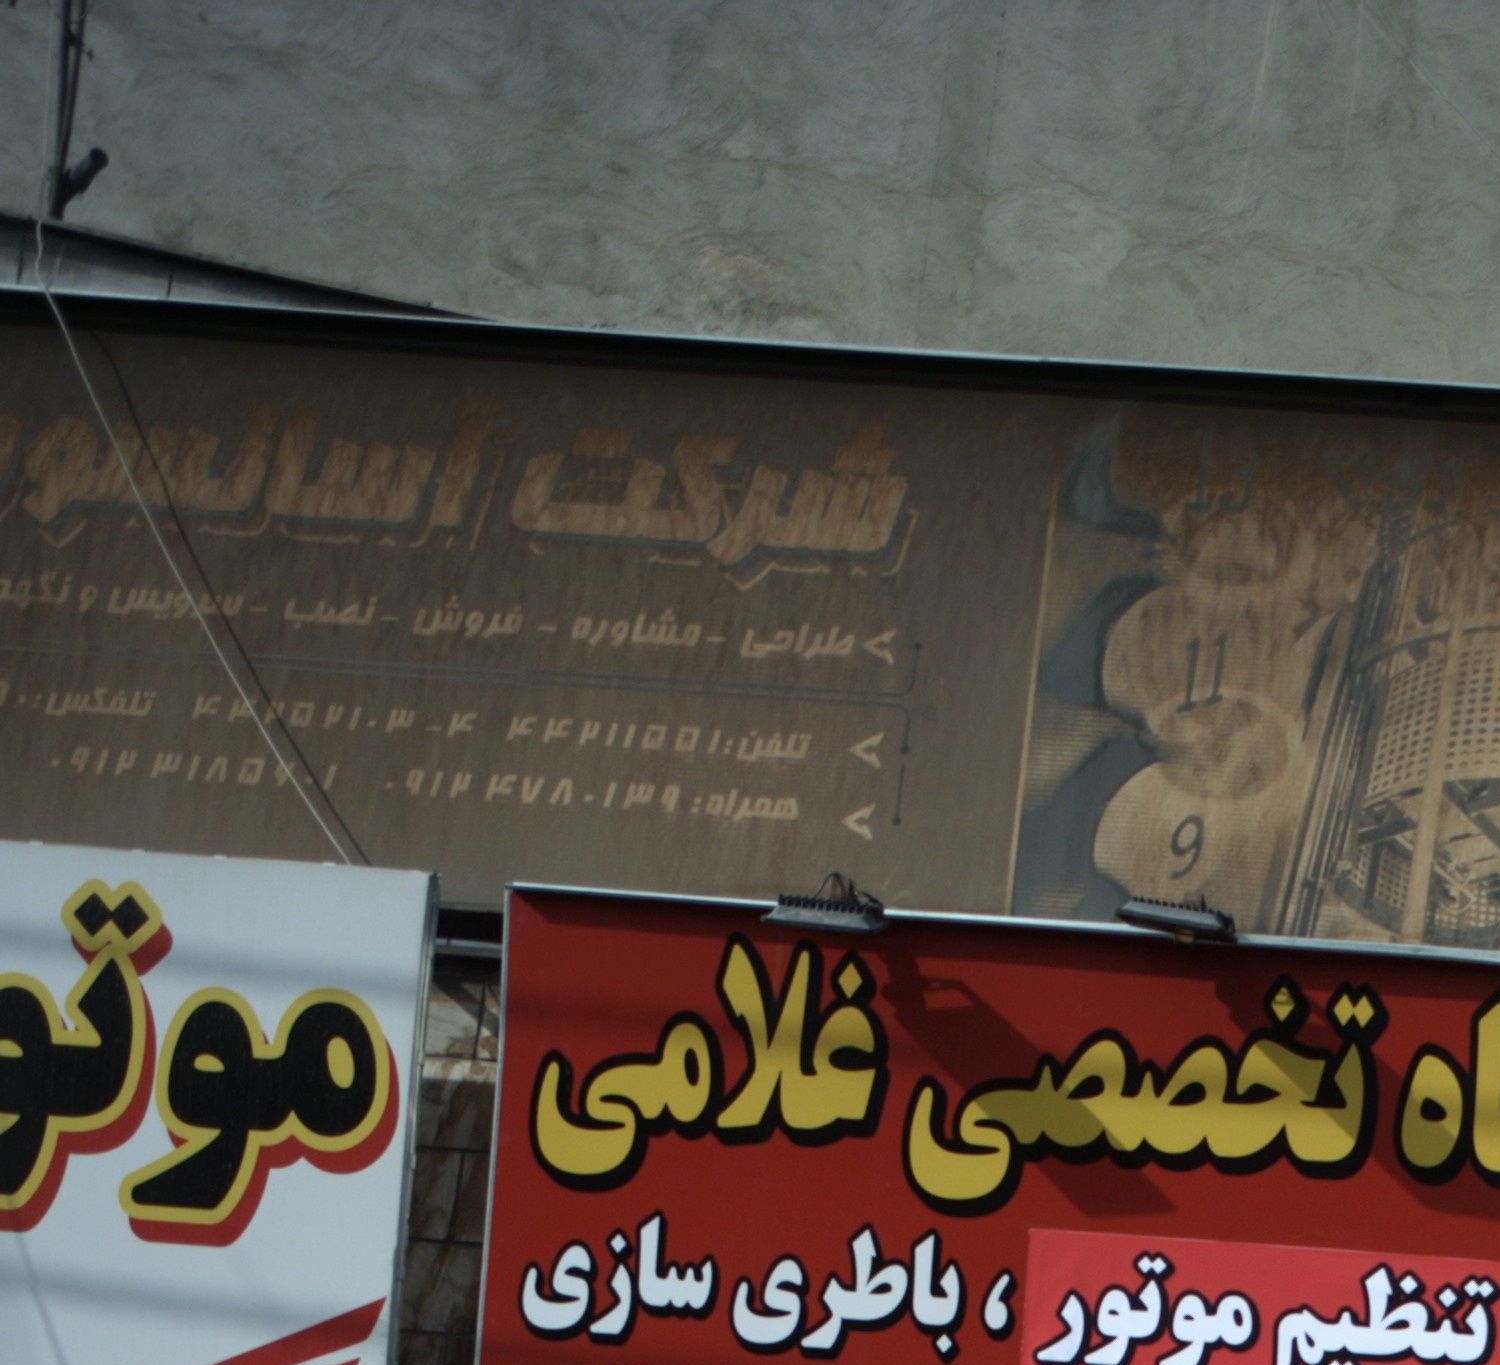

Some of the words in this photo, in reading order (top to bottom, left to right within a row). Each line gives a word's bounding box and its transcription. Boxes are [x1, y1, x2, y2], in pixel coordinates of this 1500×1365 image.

[510, 420, 910, 567] شرکت
[78, 585, 99, 614] و
[282, 594, 379, 629] نصب
[412, 594, 524, 638] فروش
[570, 607, 702, 649] مشاوره
[739, 622, 856, 661] طراحی
[530, 932, 888, 1190] غلامی
[906, 975, 1376, 1217] تخصصی
[519, 1210, 716, 1348] سازی
[728, 1222, 967, 1362] باطری
